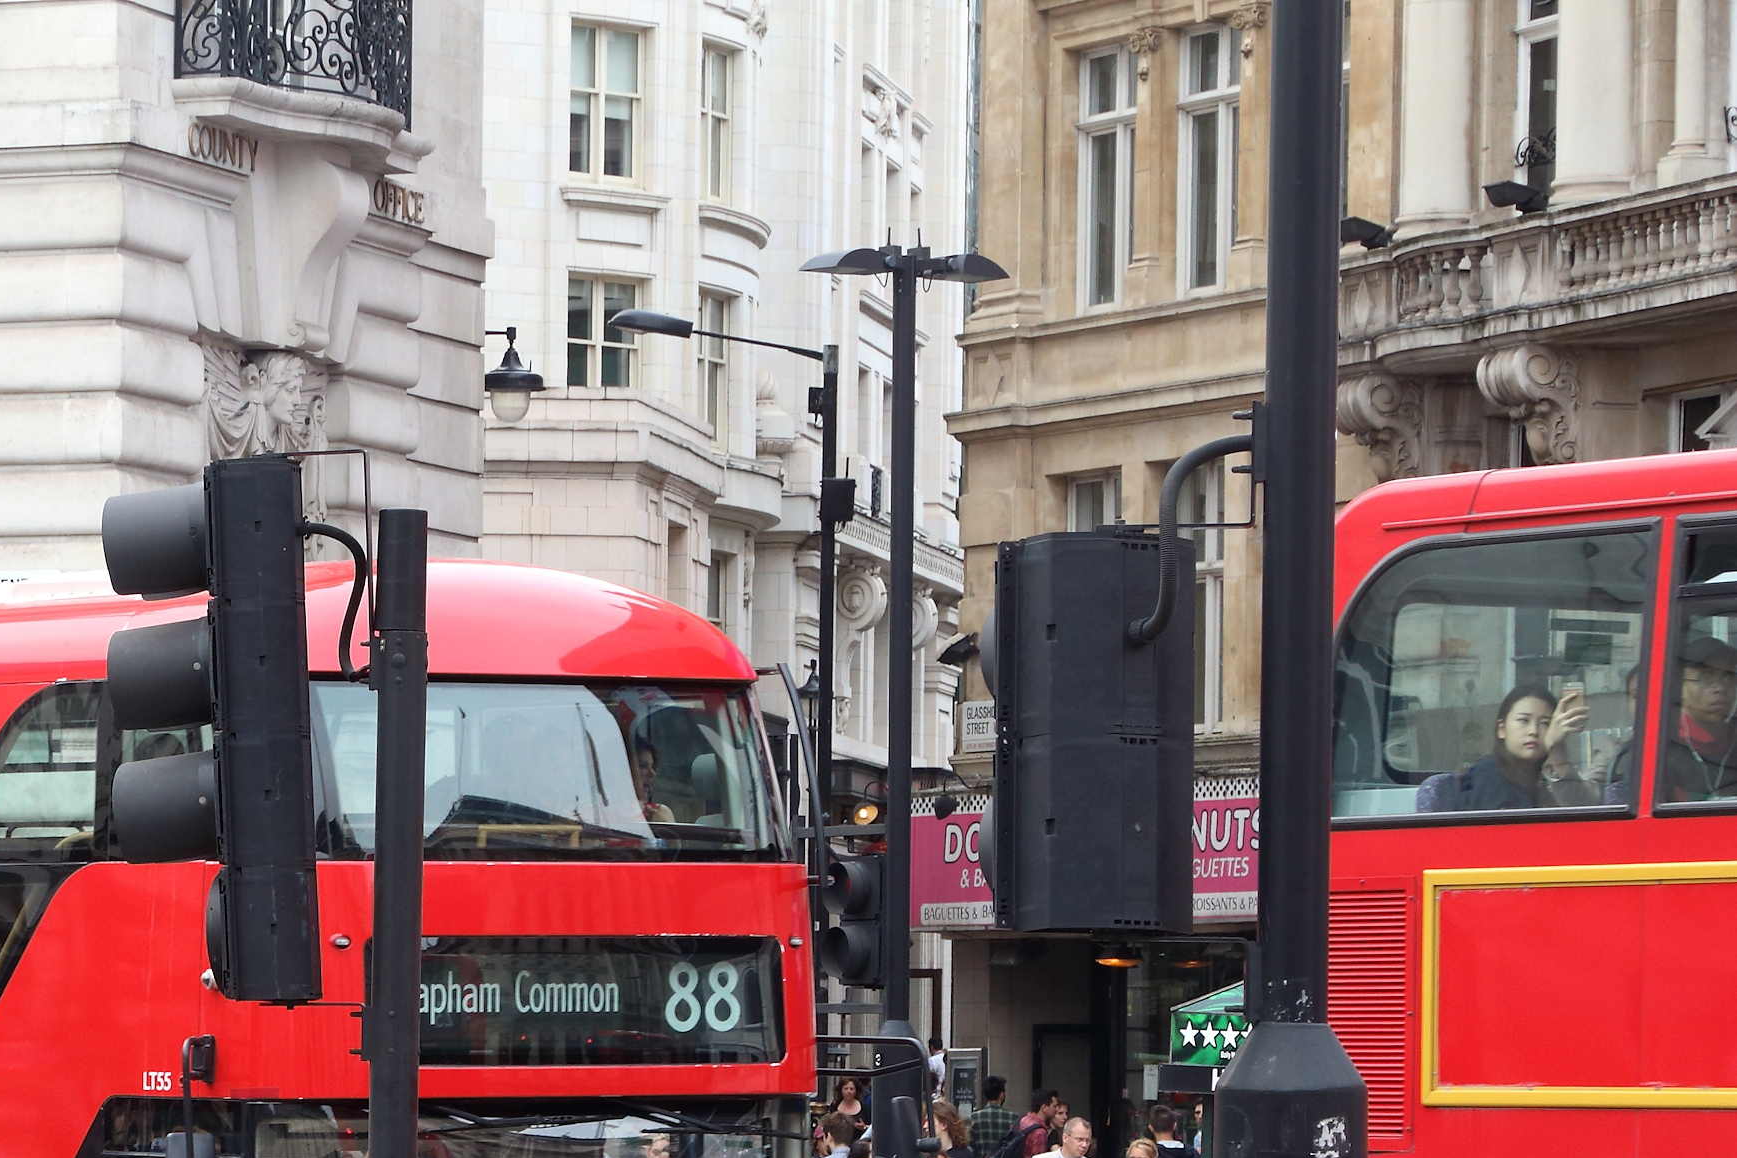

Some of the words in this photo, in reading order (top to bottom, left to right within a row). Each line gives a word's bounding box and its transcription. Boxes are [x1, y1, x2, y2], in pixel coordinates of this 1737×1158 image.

[188, 122, 258, 172] COUNTY
[373, 179, 425, 223] OFFICE
[966, 721, 990, 734] STREET
[924, 907, 970, 921] BAGUETTES
[515, 969, 620, 1014] Common
[665, 961, 742, 1033] 88
[143, 1071, 172, 1091] LT55
